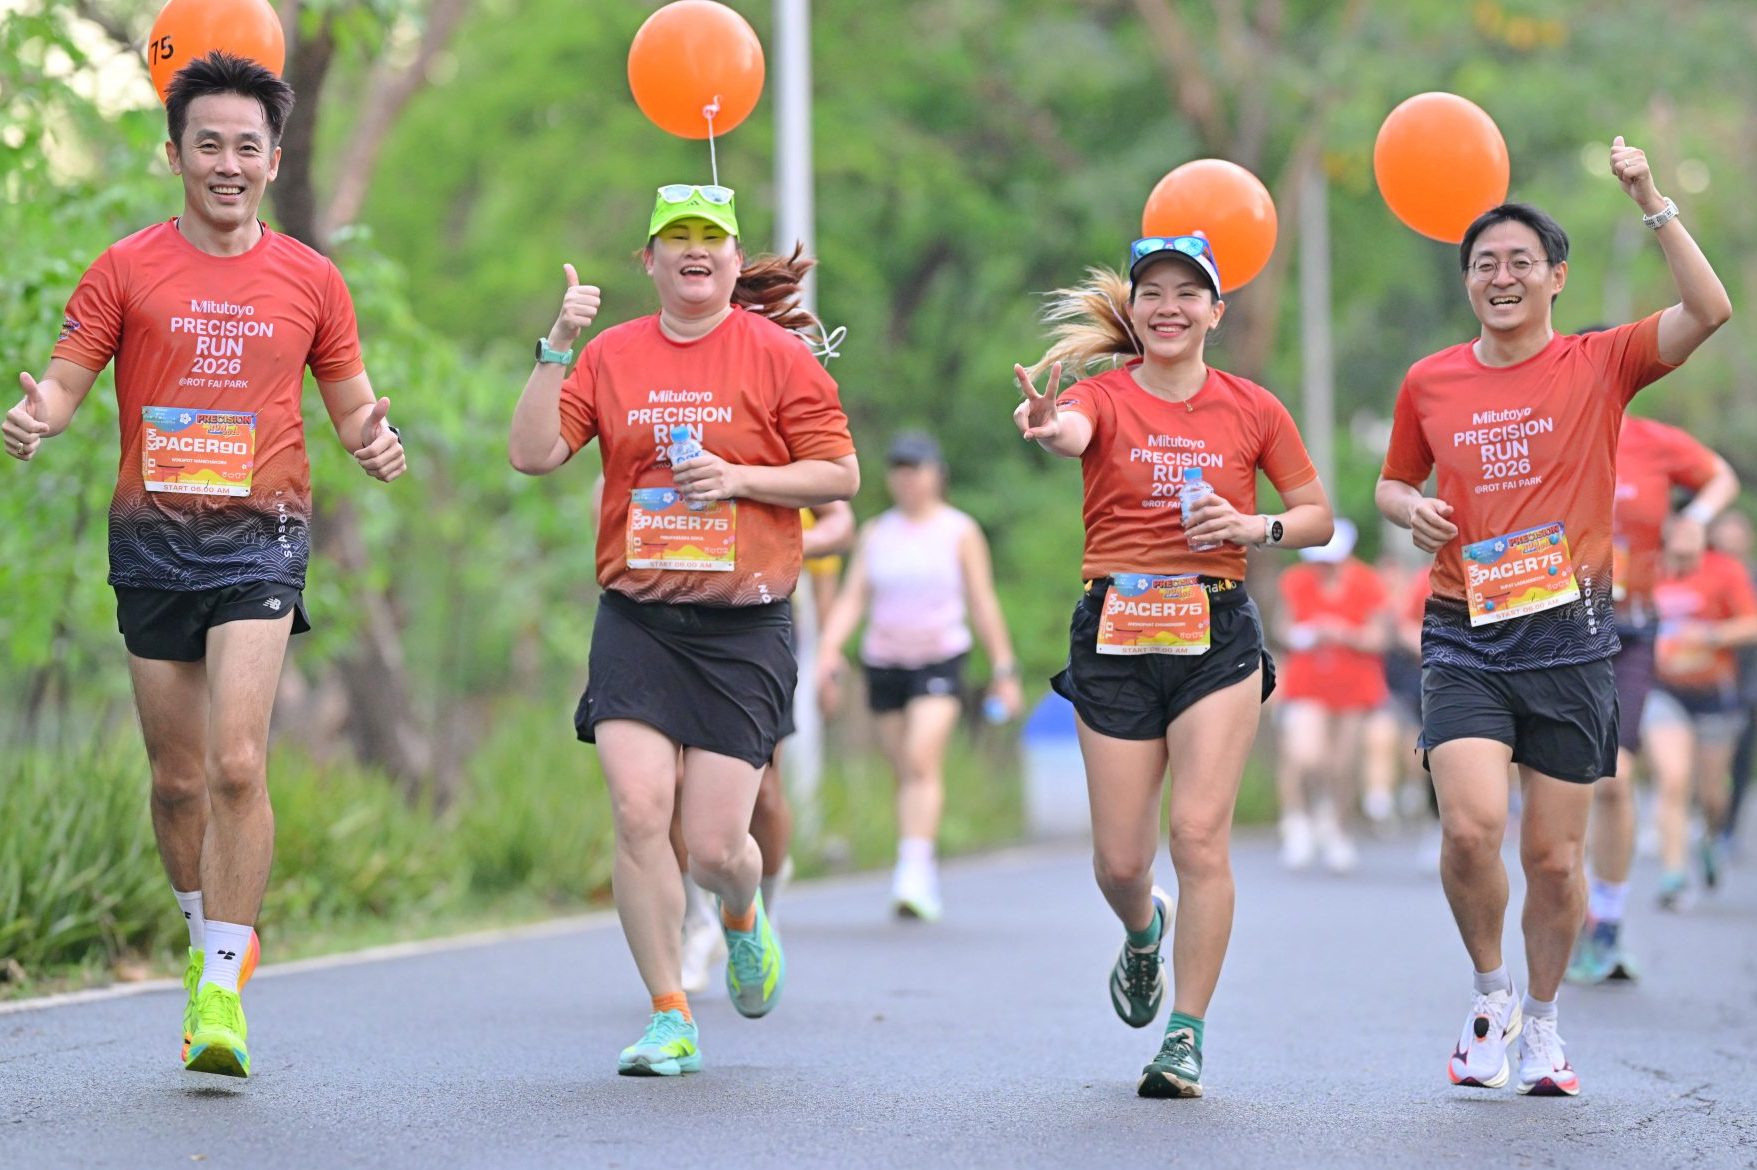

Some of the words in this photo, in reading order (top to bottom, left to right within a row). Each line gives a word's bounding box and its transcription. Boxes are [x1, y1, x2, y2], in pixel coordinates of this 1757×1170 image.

[191, 299, 255, 318] Mitutoyo
[170, 317, 274, 337] PRECISION
[196, 337, 244, 356] RUN
[191, 357, 241, 375] 2026
[178, 377, 205, 387] @ROT
[207, 379, 222, 388] FAI
[224, 379, 248, 389] PARK
[648, 390, 713, 404] Mitutoyo
[197, 414, 252, 424] PRECISION
[627, 406, 732, 426] PRECISION
[1472, 407, 1532, 425] Mitutoyo
[147, 428, 158, 451] KM
[1148, 434, 1205, 449] Mitutoyo
[1453, 417, 1553, 447] PRECISION
[156, 436, 247, 455] PACER90
[1480, 438, 1529, 463] RUN
[148, 458, 156, 475] 10
[1130, 448, 1223, 469] PRECISION
[1153, 464, 1189, 483] RU
[1482, 458, 1531, 480] 2026
[1474, 482, 1500, 495] @ROT
[1502, 480, 1517, 491] FAI
[1519, 475, 1542, 489] PARK
[1142, 500, 1166, 508] @ROT
[277, 503, 293, 558] SEASON
[640, 515, 729, 531] PACER75
[1479, 551, 1563, 585] PACER75
[1113, 601, 1202, 617] PACER75
[1584, 577, 1597, 635] SEASON
